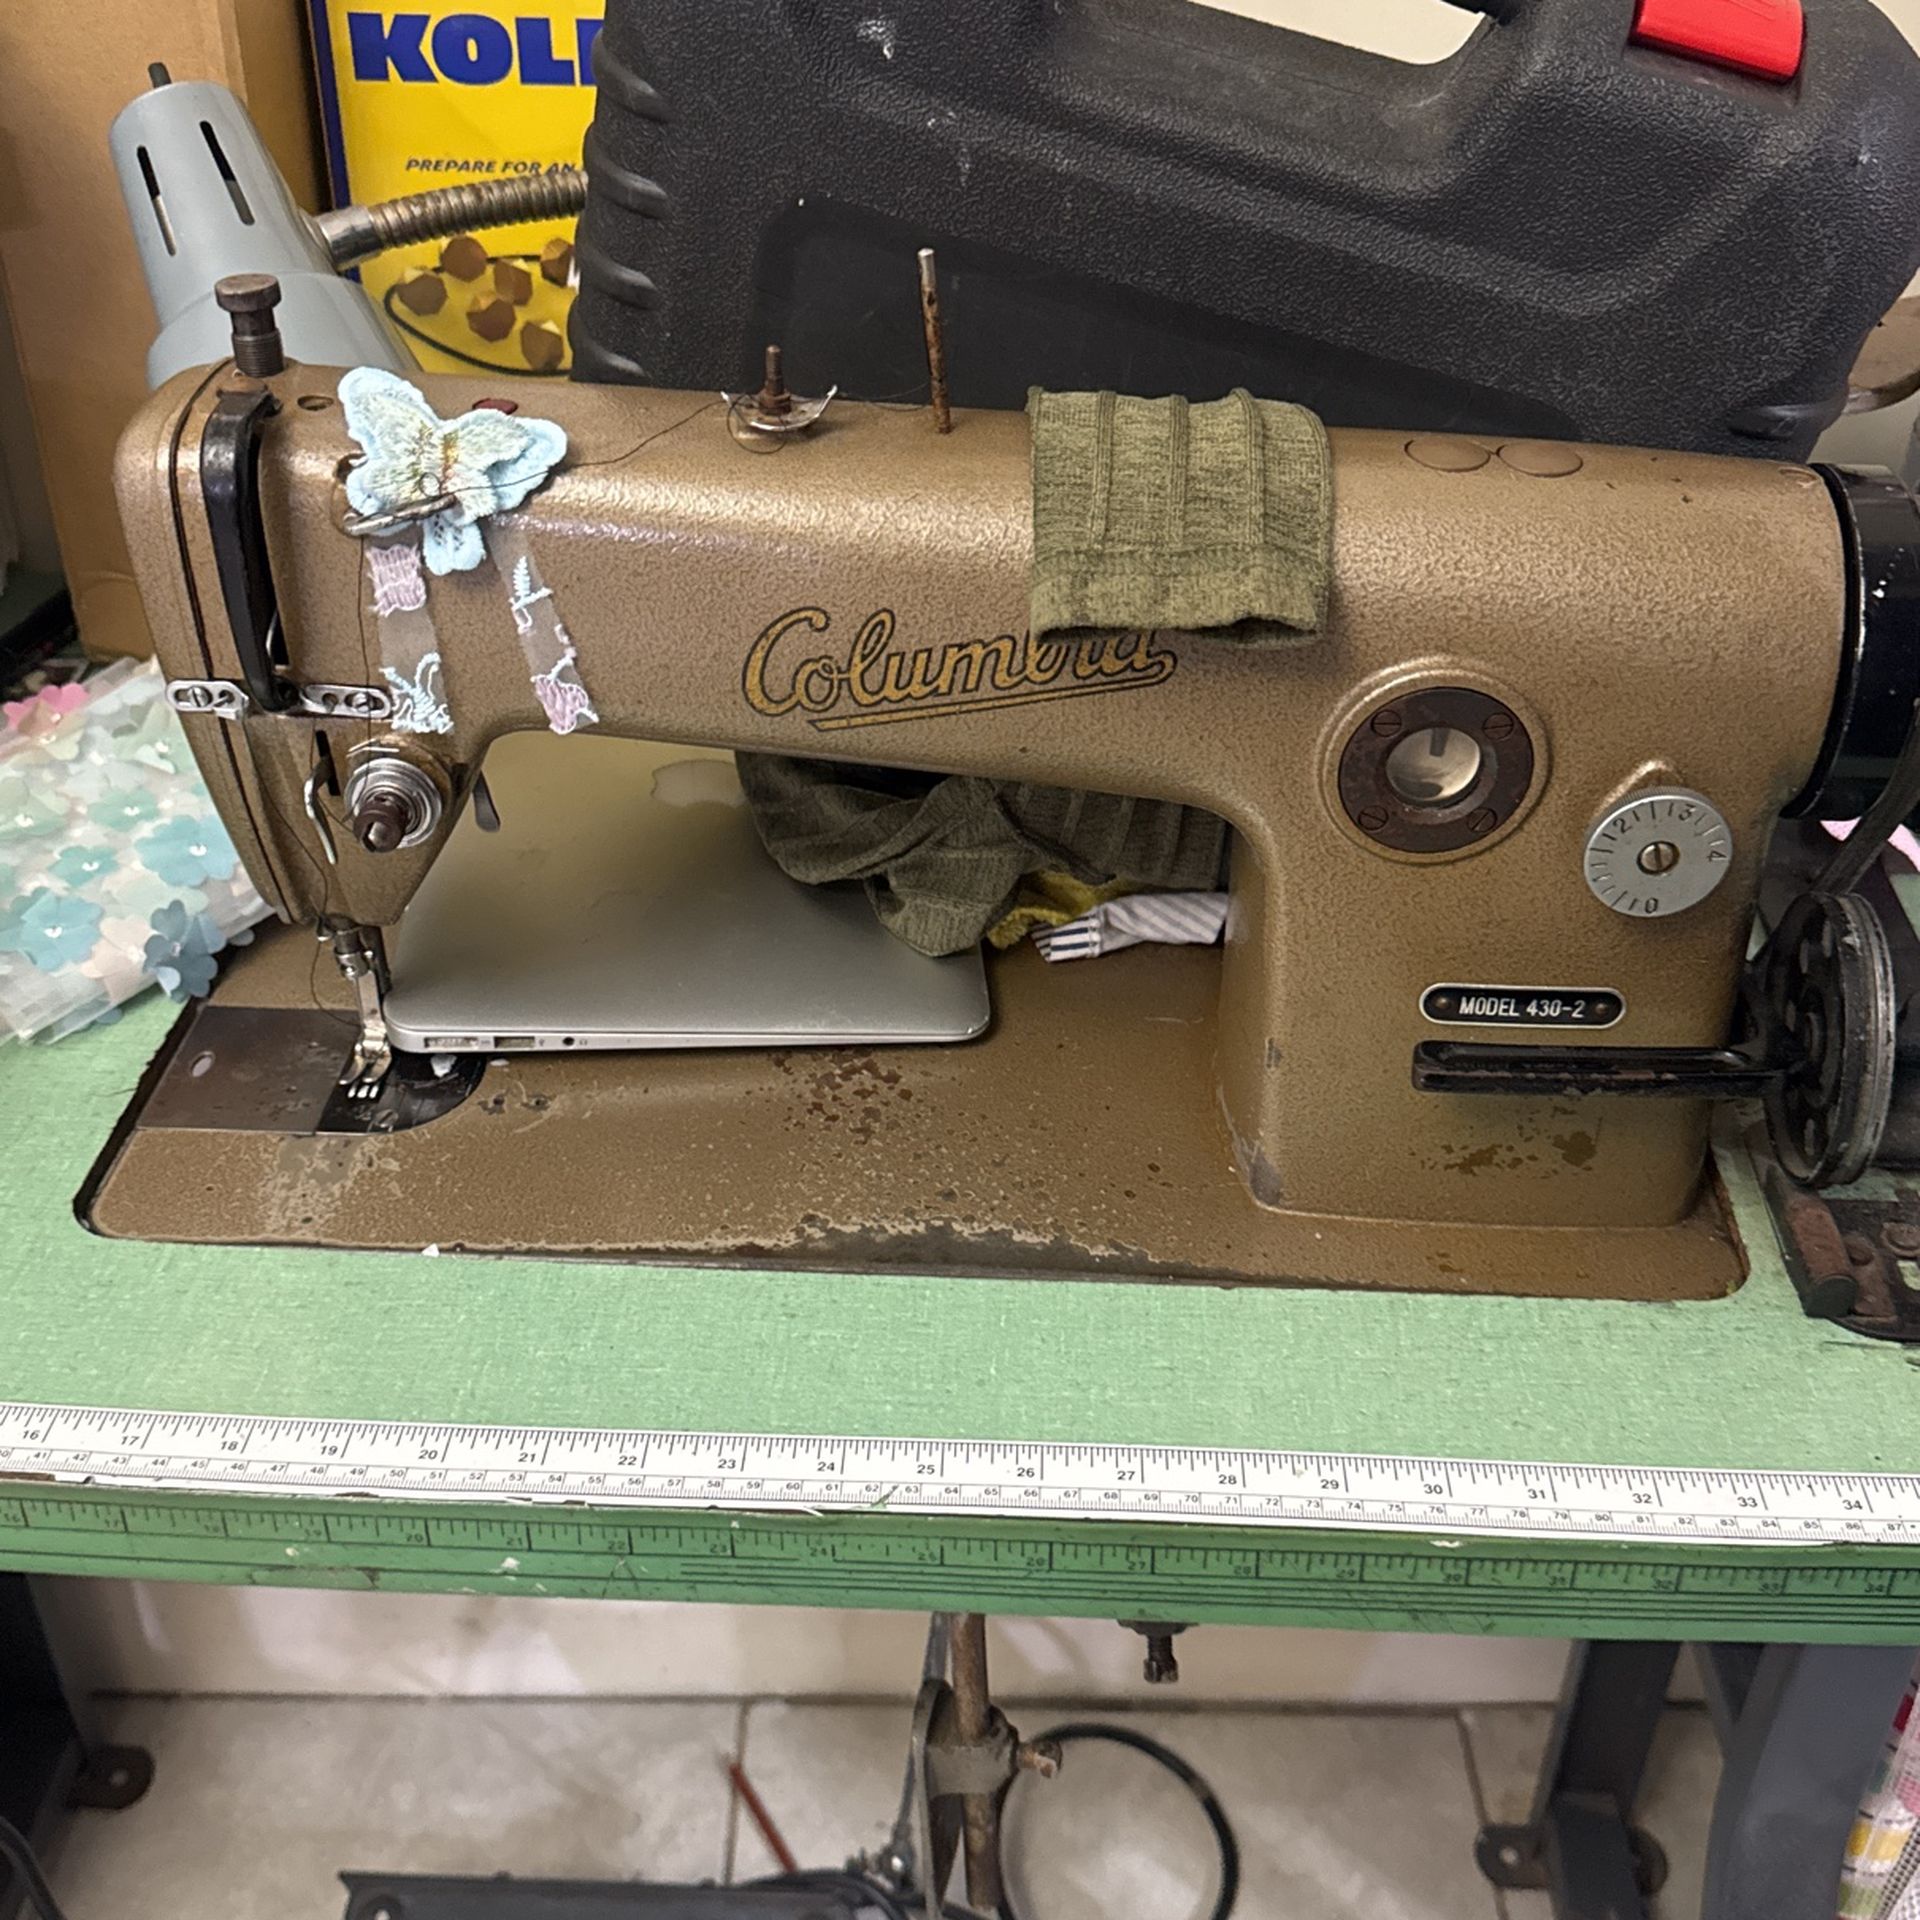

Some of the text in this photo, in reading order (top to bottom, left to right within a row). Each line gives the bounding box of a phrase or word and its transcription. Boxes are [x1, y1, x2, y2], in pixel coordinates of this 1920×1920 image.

[405, 159, 495, 173] PREPARE
[501, 161, 542, 173] FOR
[1459, 996, 1586, 1018] MODEL 430-2
[22, 1429, 1861, 1510] 16 17 18 19 20 21 22 23 24 25 26 27 28 29 30 31 32 33 34
[33, 1451, 47, 1459] 41
[73, 1453, 87, 1461] 42
[112, 1456, 126, 1464] 43
[151, 1458, 165, 1466] 44
[191, 1460, 205, 1468] 45
[230, 1462, 245, 1470] 46
[270, 1464, 284, 1472] 47
[310, 1466, 324, 1475] 48
[350, 1468, 364, 1477] 49
[390, 1469, 404, 1478] 50
[429, 1471, 443, 1479] 51
[469, 1471, 483, 1480] 52
[509, 1473, 523, 1481] 53
[548, 1474, 562, 1482] 54
[587, 1476, 601, 1484] 55
[627, 1477, 641, 1485] 56
[667, 1479, 681, 1487] 57
[707, 1480, 721, 1488] 58
[746, 1481, 760, 1489] 59
[786, 1481, 800, 1490] 60
[825, 1483, 839, 1491] 61
[865, 1483, 879, 1492] 62
[905, 1485, 919, 1493] 63
[944, 1486, 958, 1494] 64
[984, 1488, 998, 1496] 65
[1024, 1489, 1038, 1497] 66
[1064, 1491, 1078, 1499] 67
[1104, 1491, 1118, 1499] 68
[1144, 1492, 1158, 1501] 69
[1184, 1495, 1198, 1503] 70
[1224, 1496, 1239, 1505] 71
[1265, 1498, 1279, 1507] 72
[1306, 1500, 1320, 1508] 73
[1347, 1502, 1361, 1510] 74
[1388, 1503, 1402, 1511] 75
[1429, 1505, 1443, 1514] 76
[1470, 1508, 1484, 1516] 77
[1512, 1509, 1526, 1518] 78
[1554, 1511, 1568, 1520] 79
[1595, 1513, 1609, 1521] 80
[1636, 1515, 1650, 1524] 81
[1679, 1517, 1693, 1525] 82
[1720, 1519, 1734, 1527] 83
[1762, 1520, 1776, 1528] 84
[1804, 1521, 1818, 1529] 85
[1846, 1522, 1860, 1530] 86
[1887, 1523, 1901, 1531] 87
